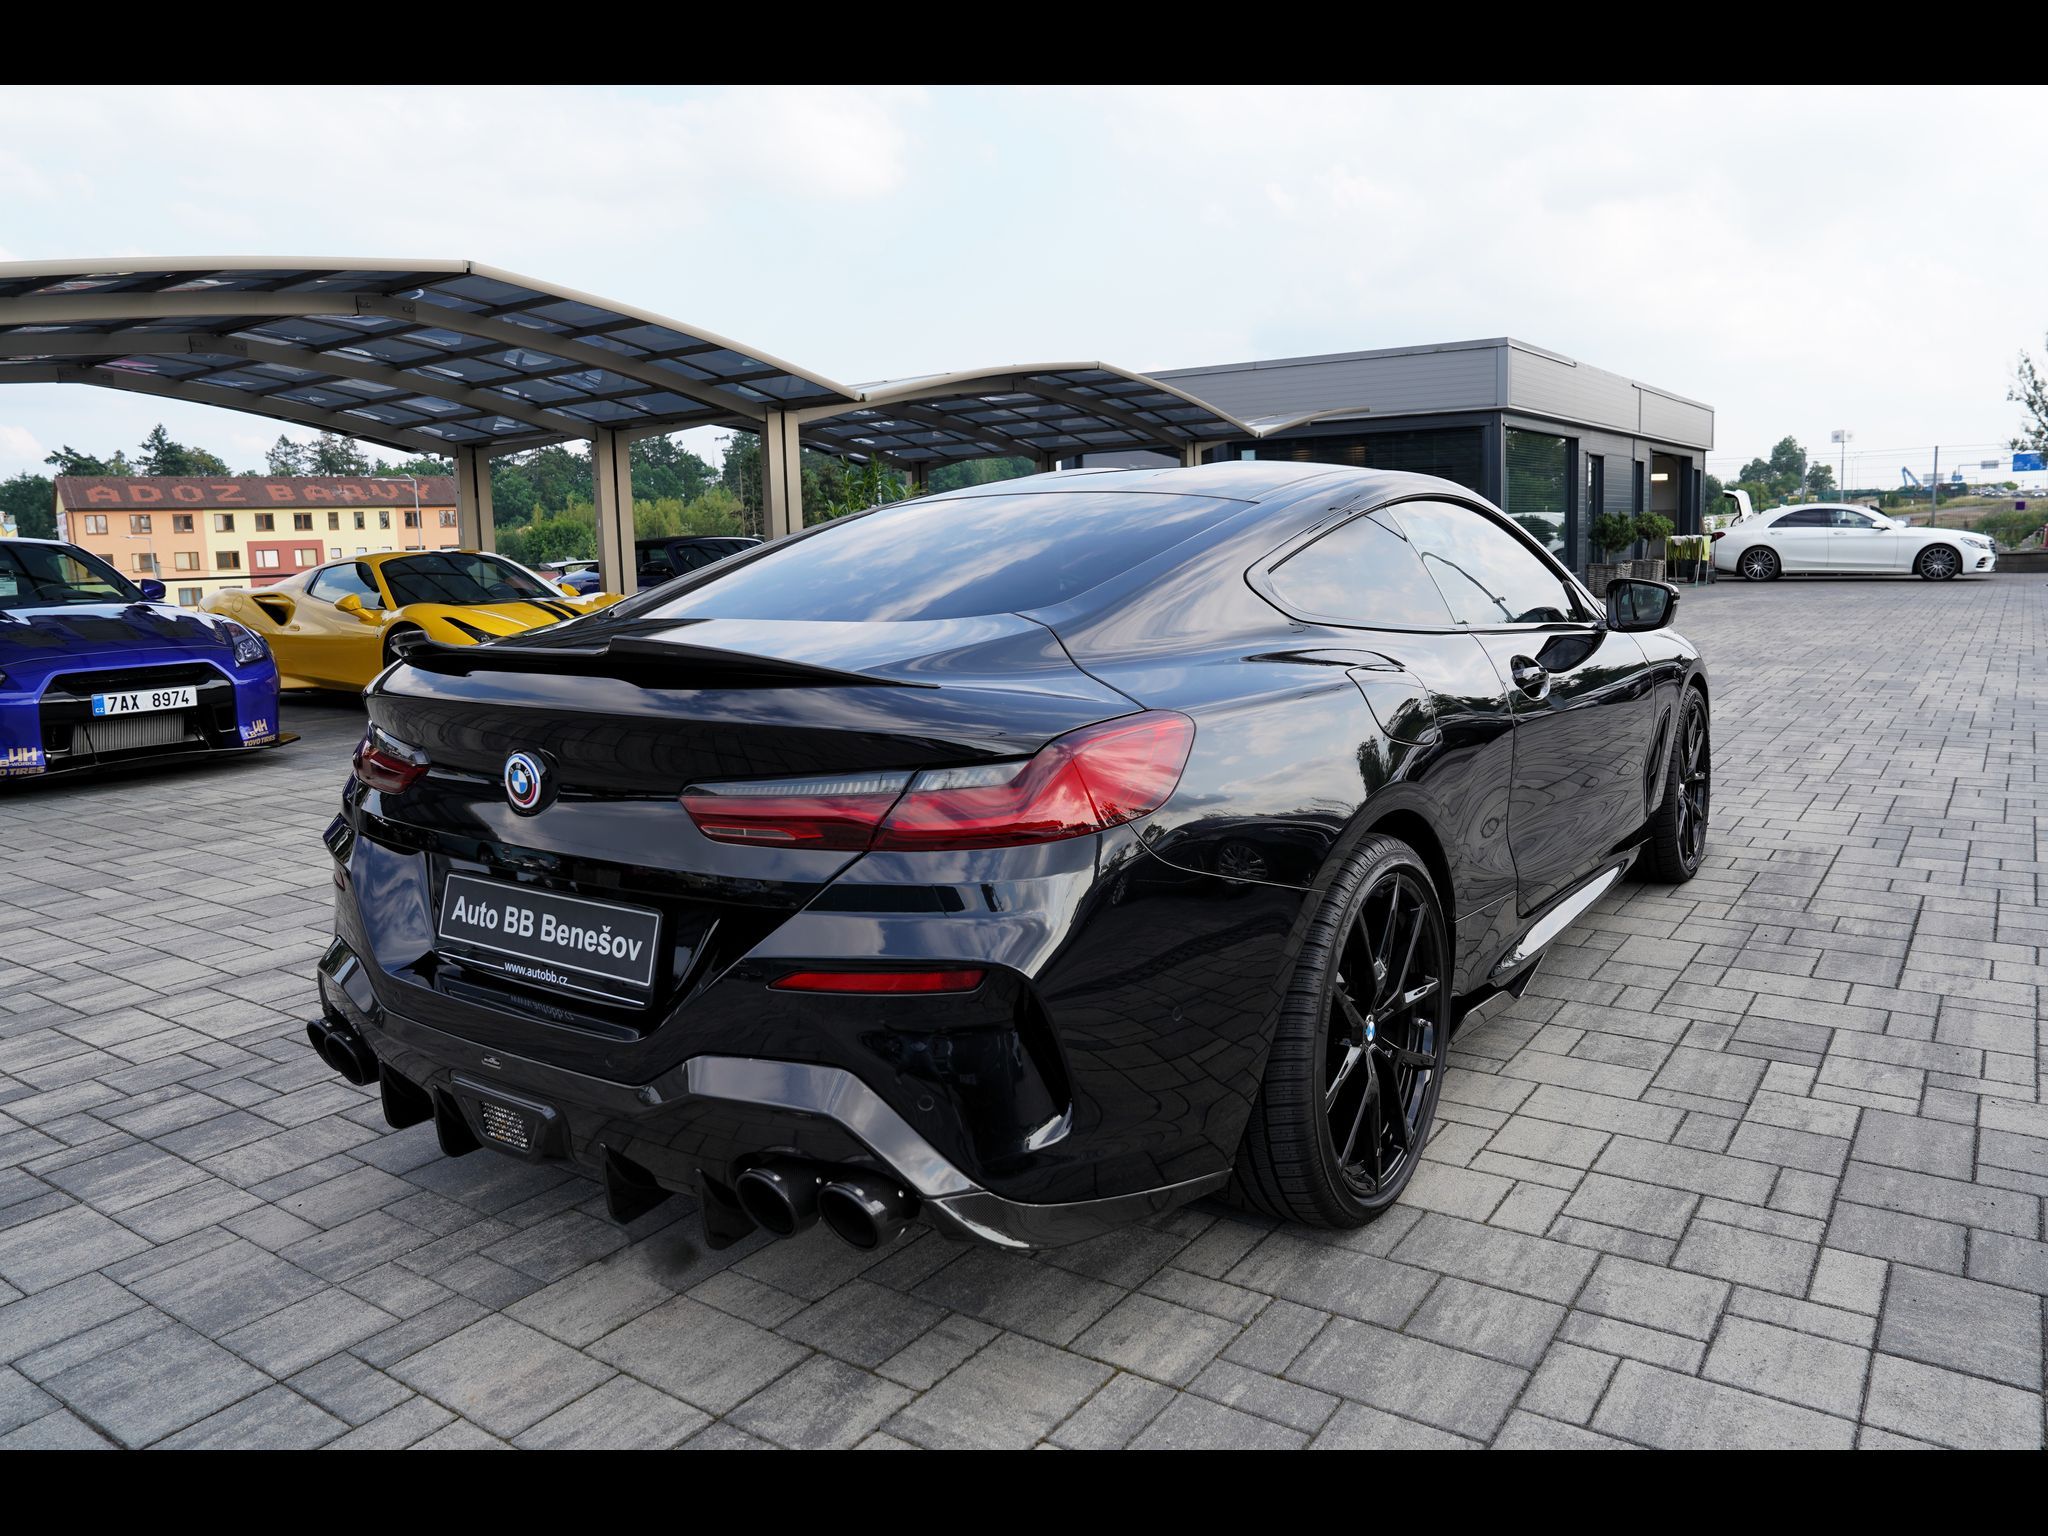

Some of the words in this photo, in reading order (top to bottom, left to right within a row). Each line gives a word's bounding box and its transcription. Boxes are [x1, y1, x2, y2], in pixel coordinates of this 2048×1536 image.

[86, 484, 247, 502] ADOZ
[108, 694, 140, 712] 7AX
[152, 690, 190, 708] 8974
[9, 766, 45, 775] TIRES
[451, 896, 498, 930] Auto
[503, 905, 535, 938] BB
[540, 914, 643, 961] Benešov
[504, 961, 568, 985] www.autobb.cz
